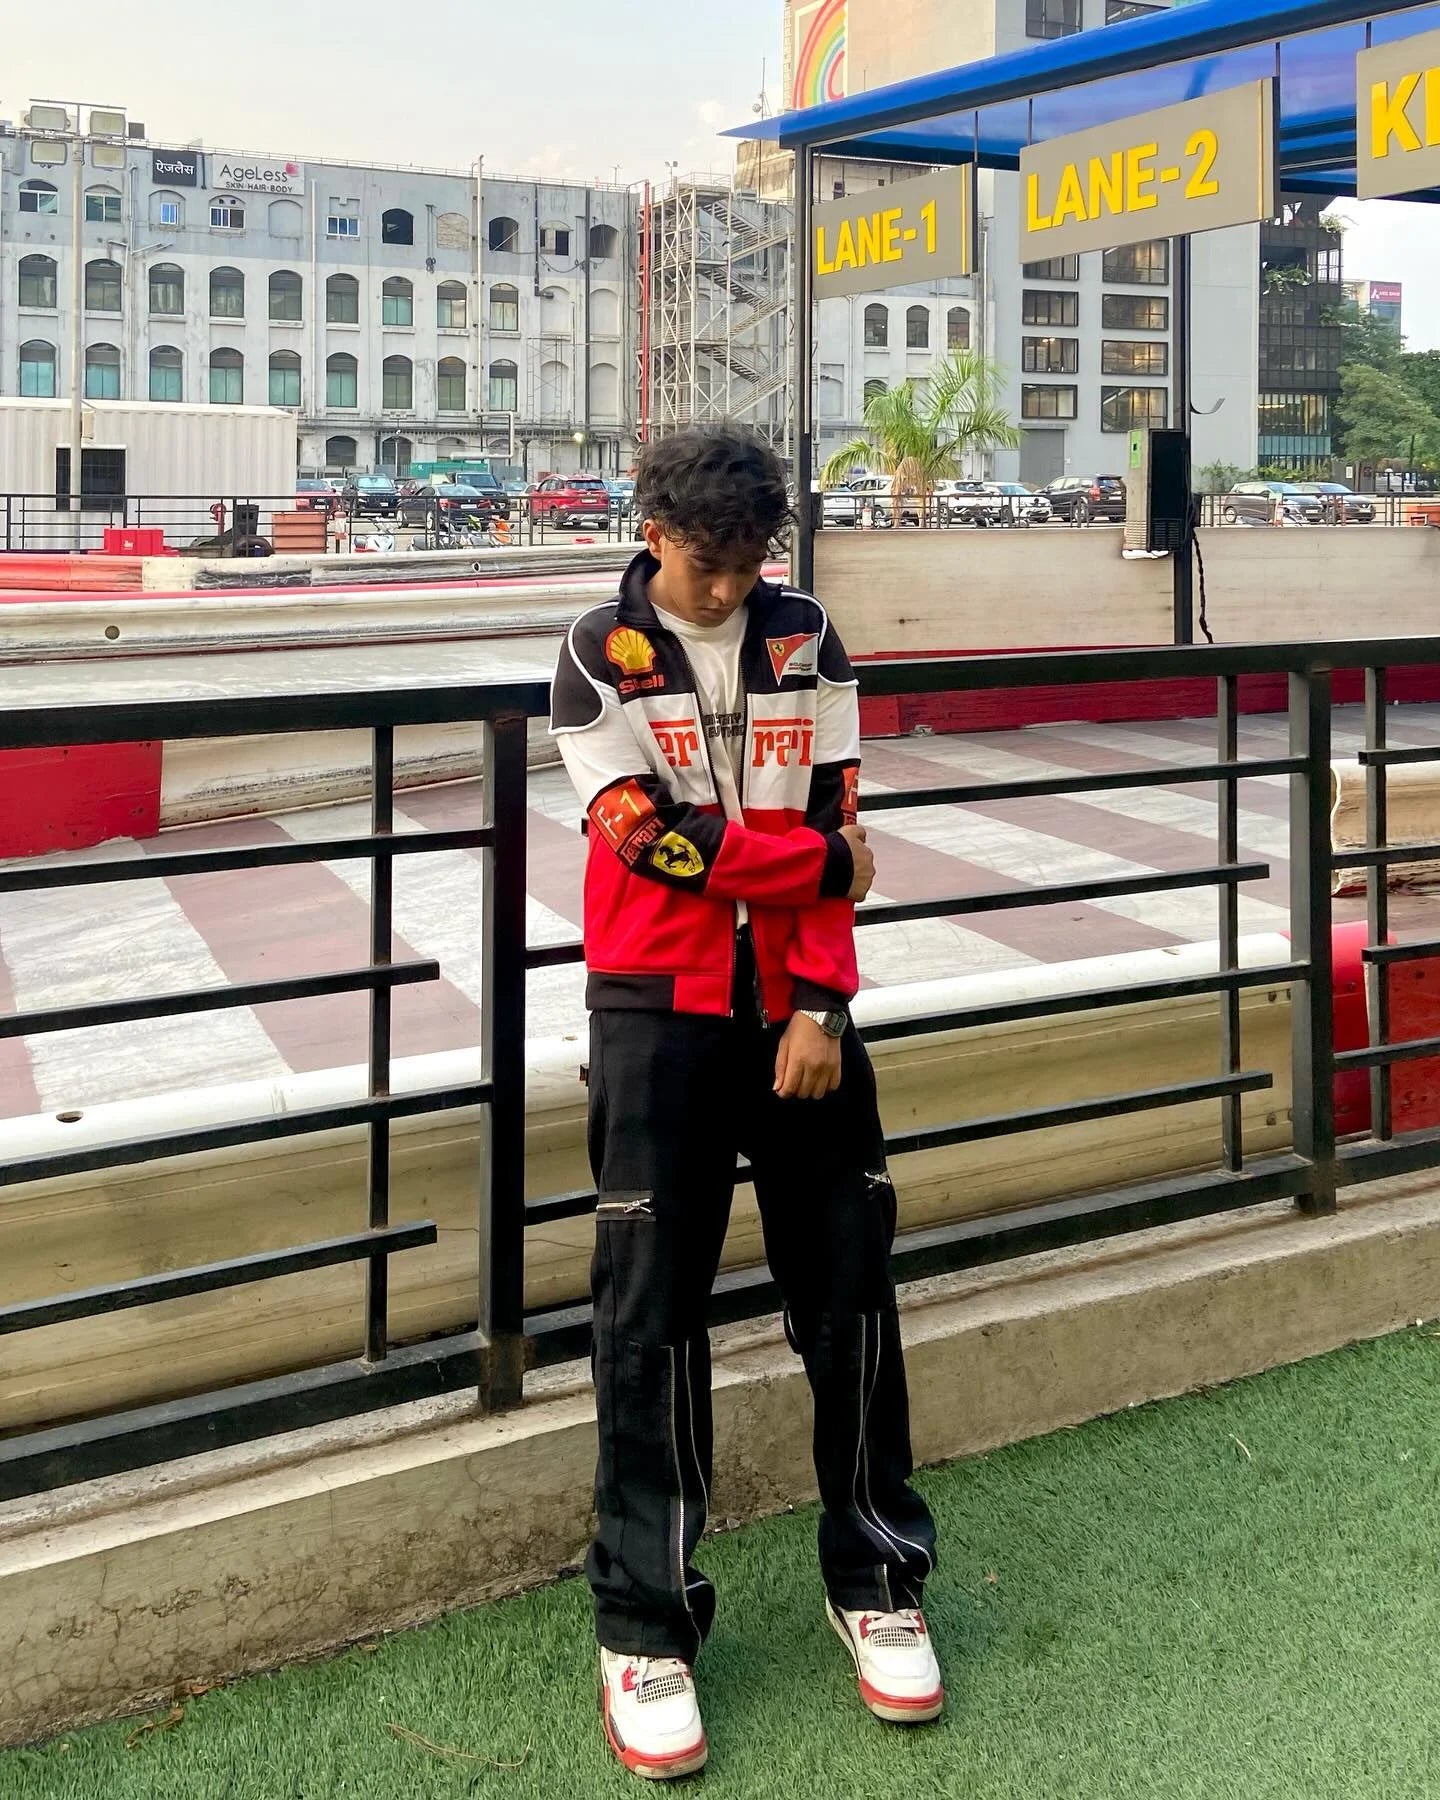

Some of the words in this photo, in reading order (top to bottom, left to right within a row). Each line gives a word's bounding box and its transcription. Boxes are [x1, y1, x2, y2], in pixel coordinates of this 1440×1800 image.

[156, 160, 195, 175] ऐजलेस
[226, 181, 244, 189] SKIN
[248, 184, 267, 192] HAIR
[270, 185, 293, 193] BODY
[1027, 128, 1219, 232] LANE-2
[816, 199, 937, 275] LANE-1
[649, 719, 699, 767] er
[596, 790, 641, 840] F-1
